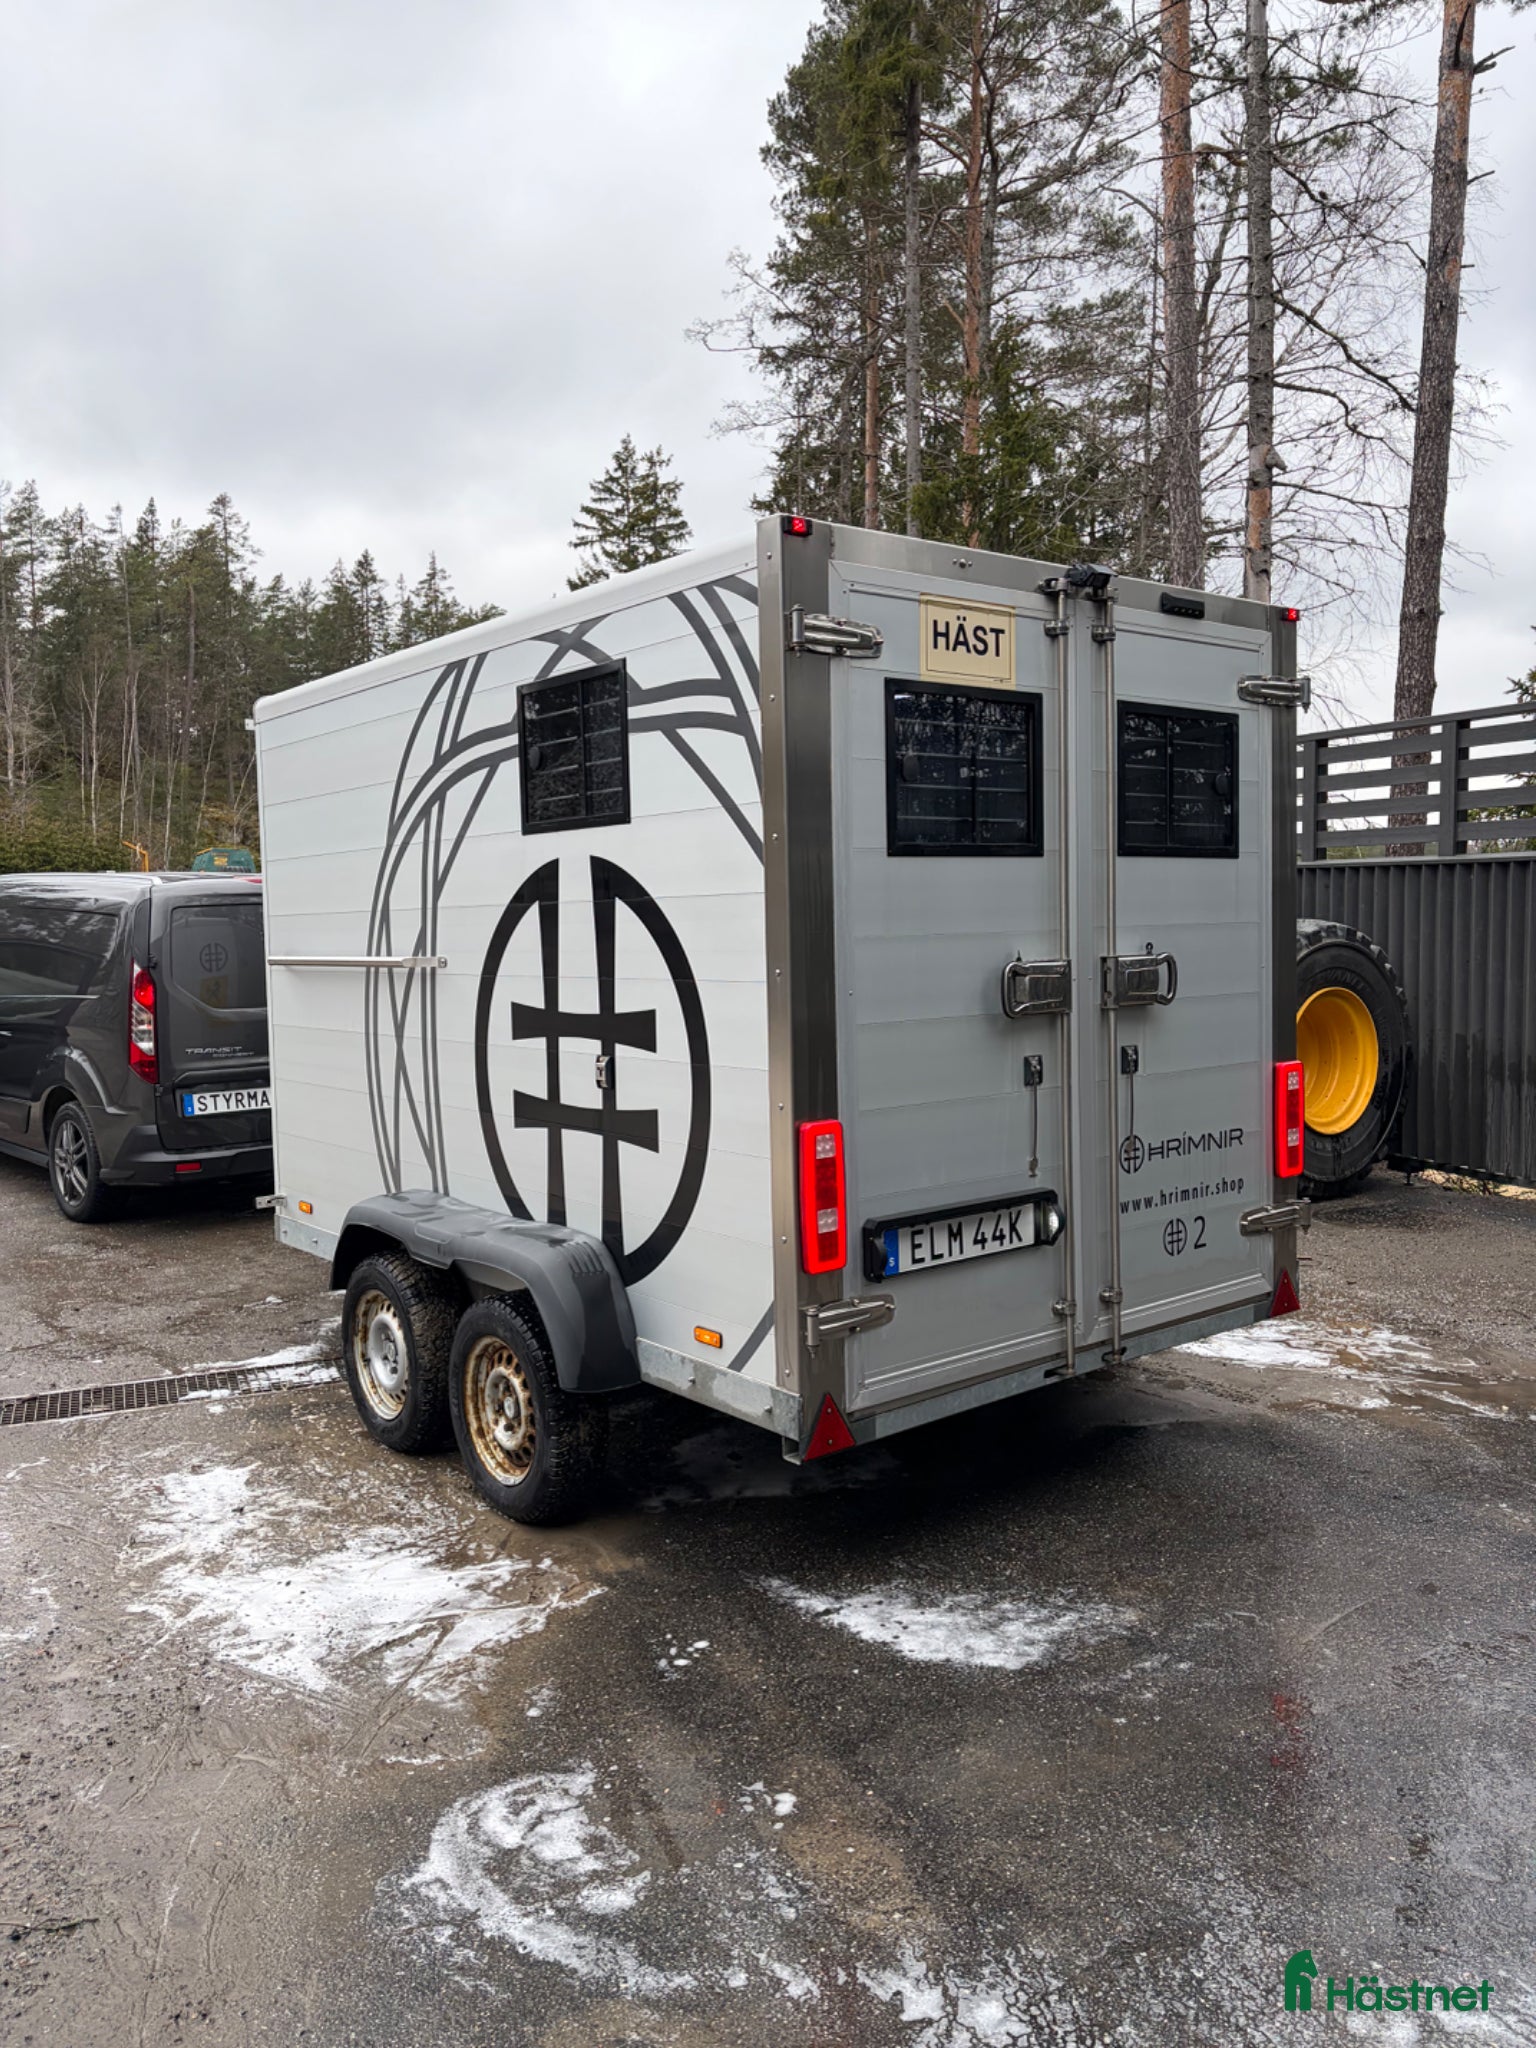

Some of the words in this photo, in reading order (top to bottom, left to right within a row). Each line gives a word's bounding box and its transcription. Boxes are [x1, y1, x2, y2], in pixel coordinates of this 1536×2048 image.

[932, 615, 1005, 657] HÄST
[185, 1046, 242, 1055] TRANSIT
[197, 1090, 271, 1112] STYRMA
[1148, 1128, 1244, 1161] HRÍMNIR
[1119, 1176, 1245, 1214] www.hrimnir.shop
[911, 1221, 963, 1265] ELM
[973, 1210, 1023, 1250] 44K
[1194, 1215, 1207, 1249] 2
